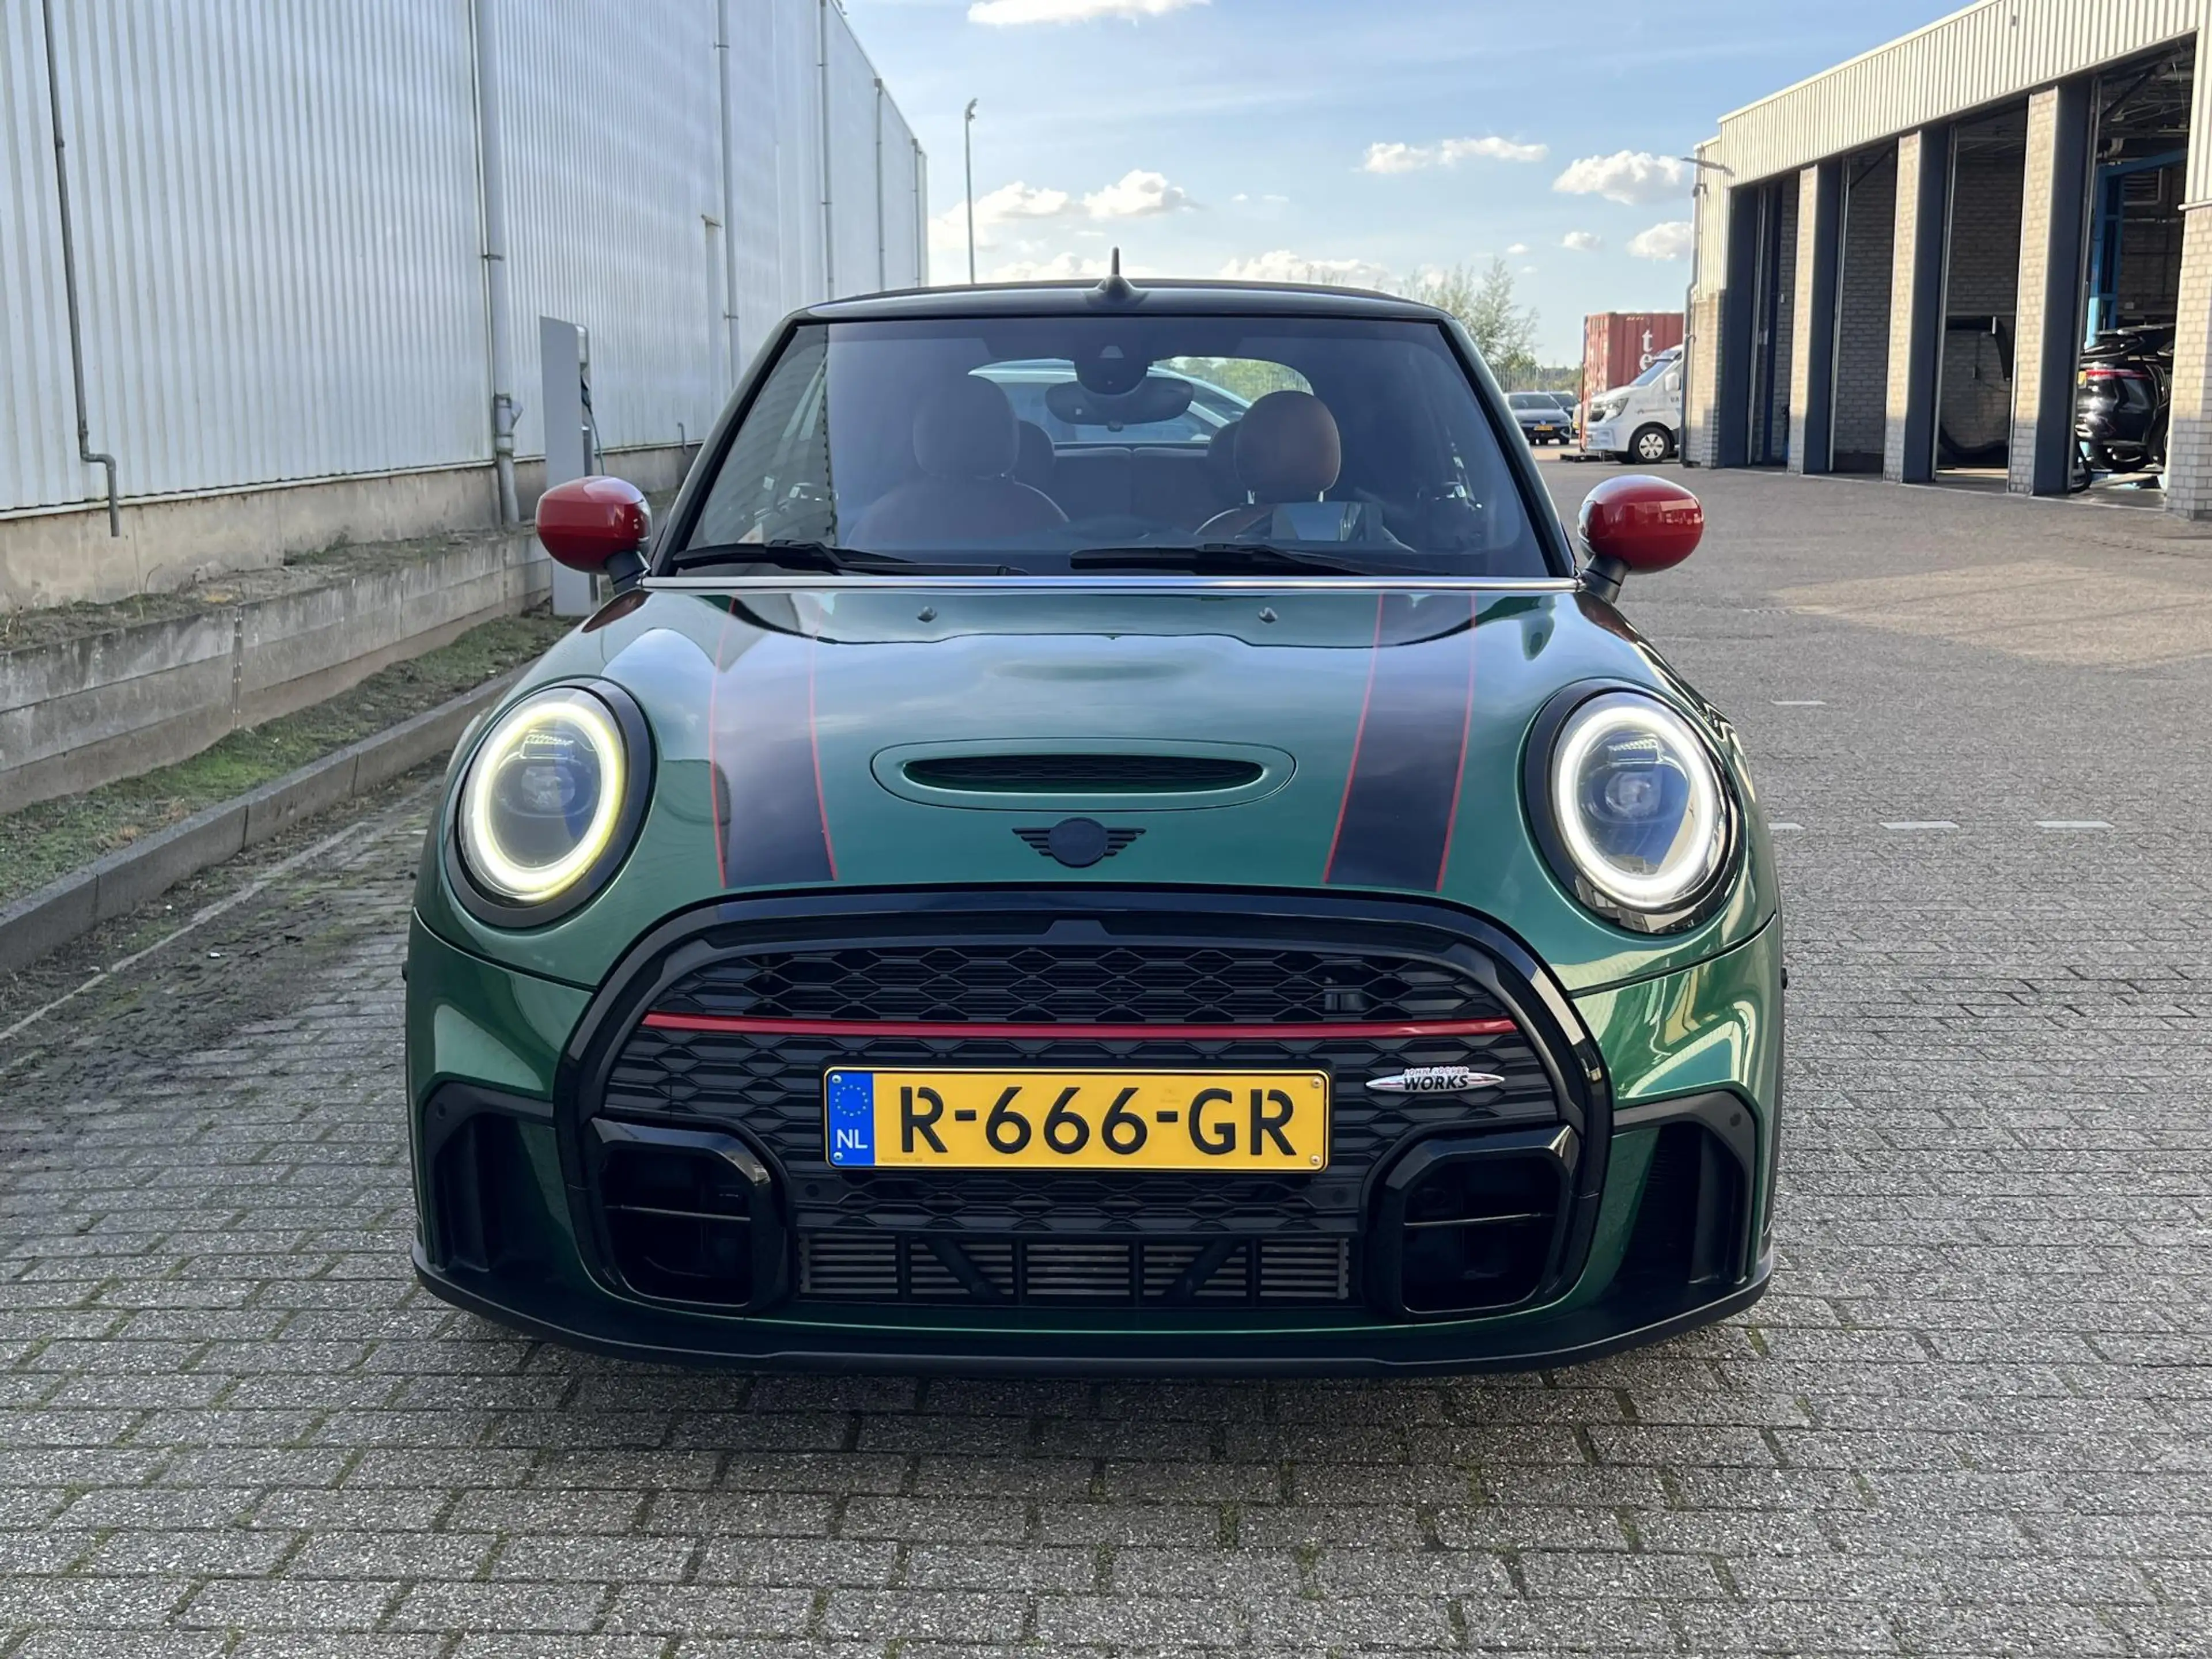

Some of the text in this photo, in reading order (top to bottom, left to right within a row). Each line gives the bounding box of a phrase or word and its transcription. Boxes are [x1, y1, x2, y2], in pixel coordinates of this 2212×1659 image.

[1404, 1075, 1469, 1090] WORKS
[900, 1086, 1297, 1156] R-666-GR
[837, 1130, 868, 1149] NL
